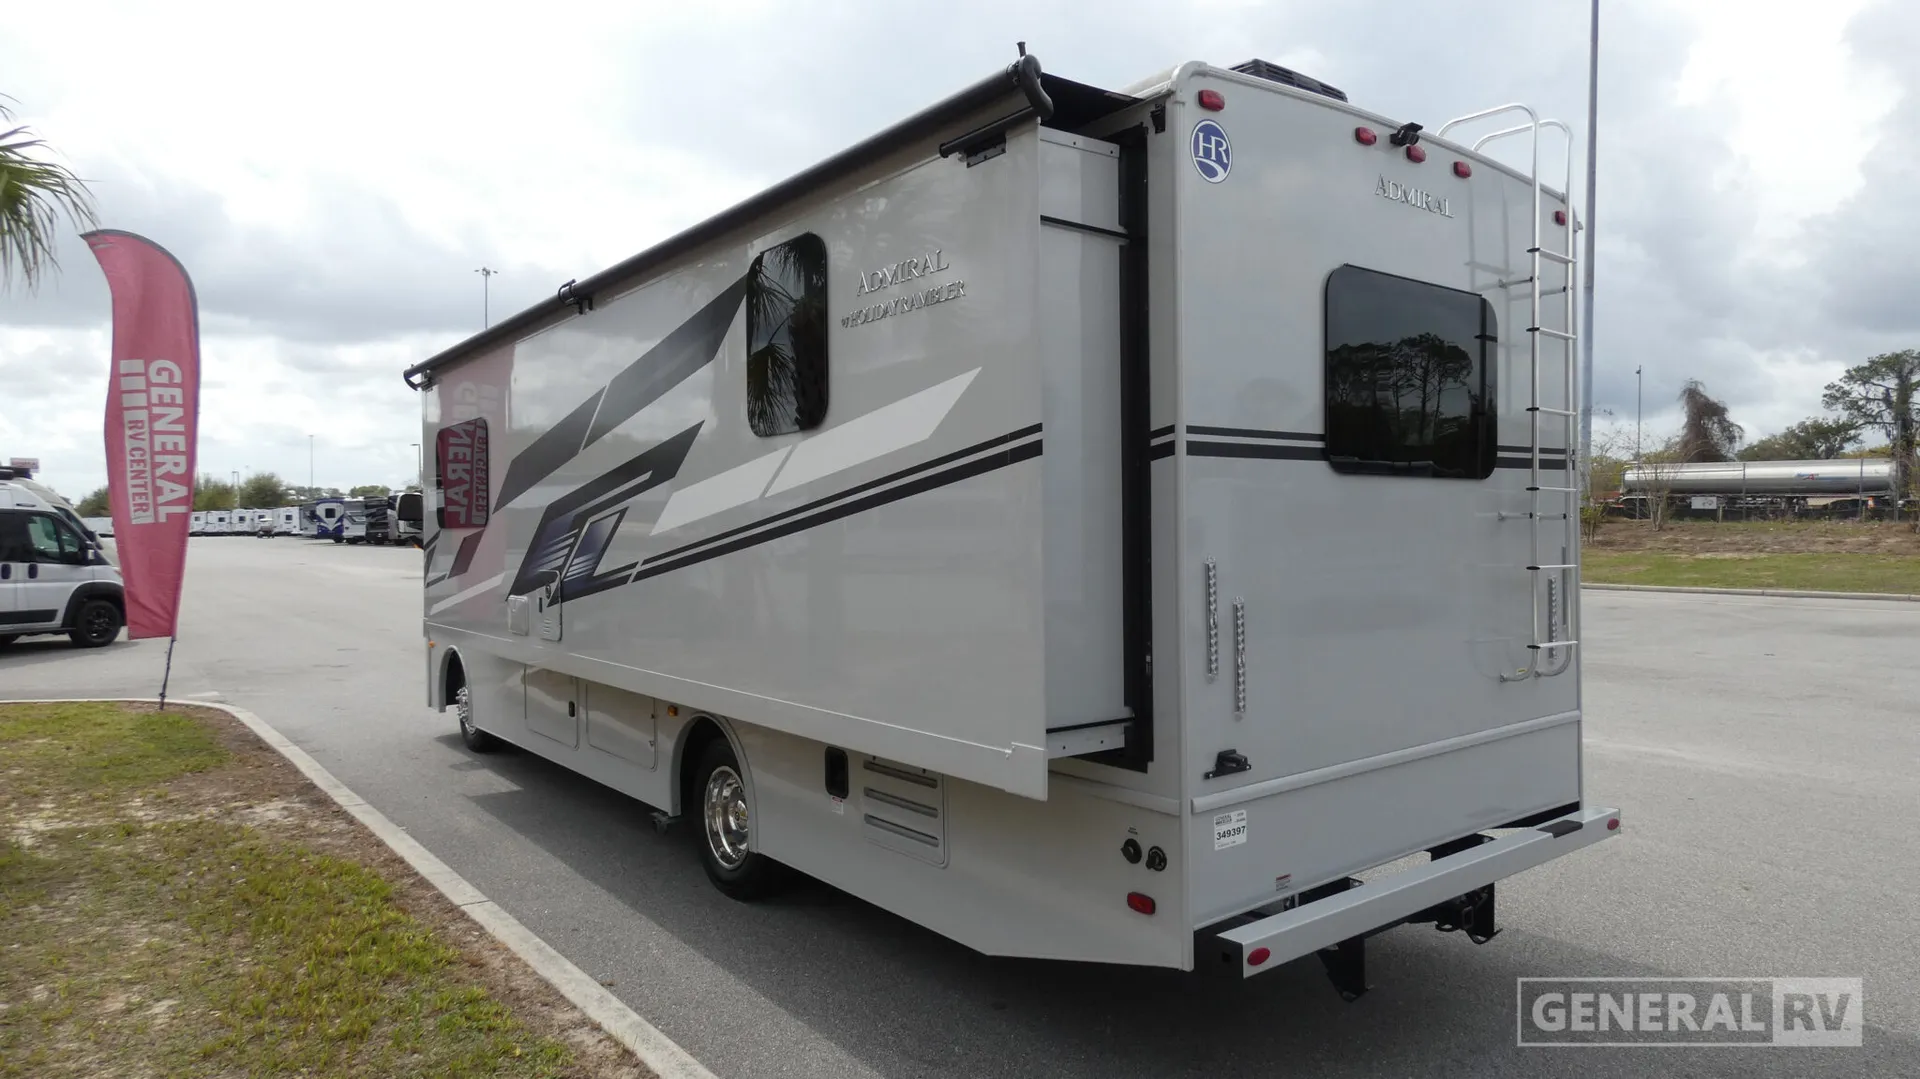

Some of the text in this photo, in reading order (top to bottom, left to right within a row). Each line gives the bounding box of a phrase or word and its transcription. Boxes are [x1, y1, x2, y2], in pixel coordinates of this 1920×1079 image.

[1197, 131, 1229, 164] HR
[1375, 172, 1455, 218] ADMIRAL
[857, 248, 950, 297] ADMIRAL
[850, 298, 899, 328] HOLIDAY
[900, 279, 966, 314] RAMBLER
[149, 359, 189, 523] GENERAL
[127, 419, 151, 514] RV CENTER
[1216, 825, 1246, 841] 349397
